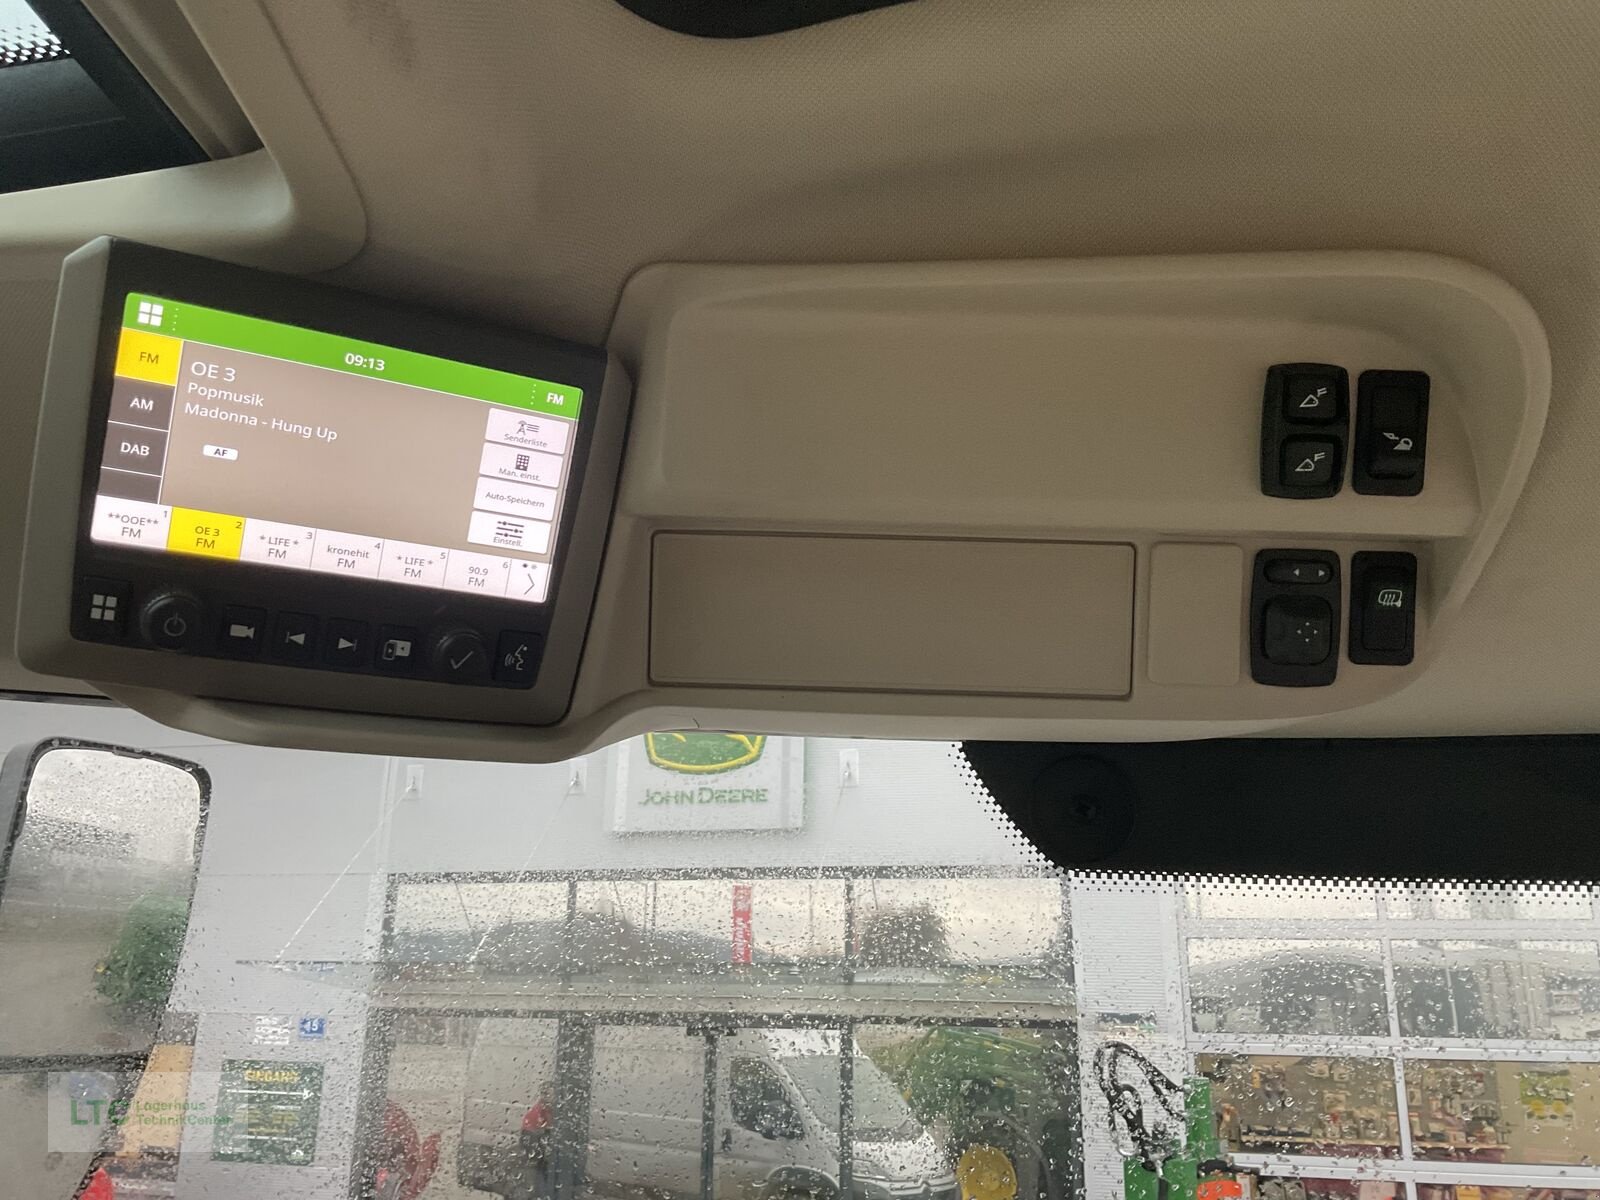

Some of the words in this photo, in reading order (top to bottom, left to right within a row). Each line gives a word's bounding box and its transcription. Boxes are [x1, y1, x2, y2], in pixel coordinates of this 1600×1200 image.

[139, 351, 160, 365] FM
[344, 352, 385, 371] 09:13
[190, 361, 219, 379] OE
[223, 367, 237, 382] 3
[187, 382, 265, 407] Popmusik
[546, 392, 565, 405] FM
[129, 397, 154, 411] AM
[184, 402, 258, 427] Madonna
[271, 418, 313, 439] Hung
[316, 427, 338, 443] Up
[503, 432, 548, 449] Senderliste
[120, 442, 150, 456] DAB
[213, 448, 228, 457] AF
[498, 467, 518, 479] Man.
[519, 470, 541, 482] einst.
[485, 491, 545, 509] Auto-Speichern
[163, 510, 168, 518] 1
[194, 525, 211, 537] OE
[212, 528, 221, 537] 3
[235, 521, 243, 530] 2
[121, 526, 142, 539] FM
[306, 531, 313, 540] 3
[195, 537, 216, 550] FM
[267, 536, 291, 548] LIFE
[374, 542, 381, 550] 4
[492, 536, 524, 548] Einstell.
[267, 547, 287, 559] FM
[327, 544, 370, 559] kronehit
[440, 552, 446, 560] 5
[336, 558, 356, 569] FM
[404, 556, 426, 567] LIFE
[502, 561, 509, 569] 6
[403, 567, 422, 578] FM
[467, 566, 489, 577] 90.9
[467, 577, 485, 588] FM
